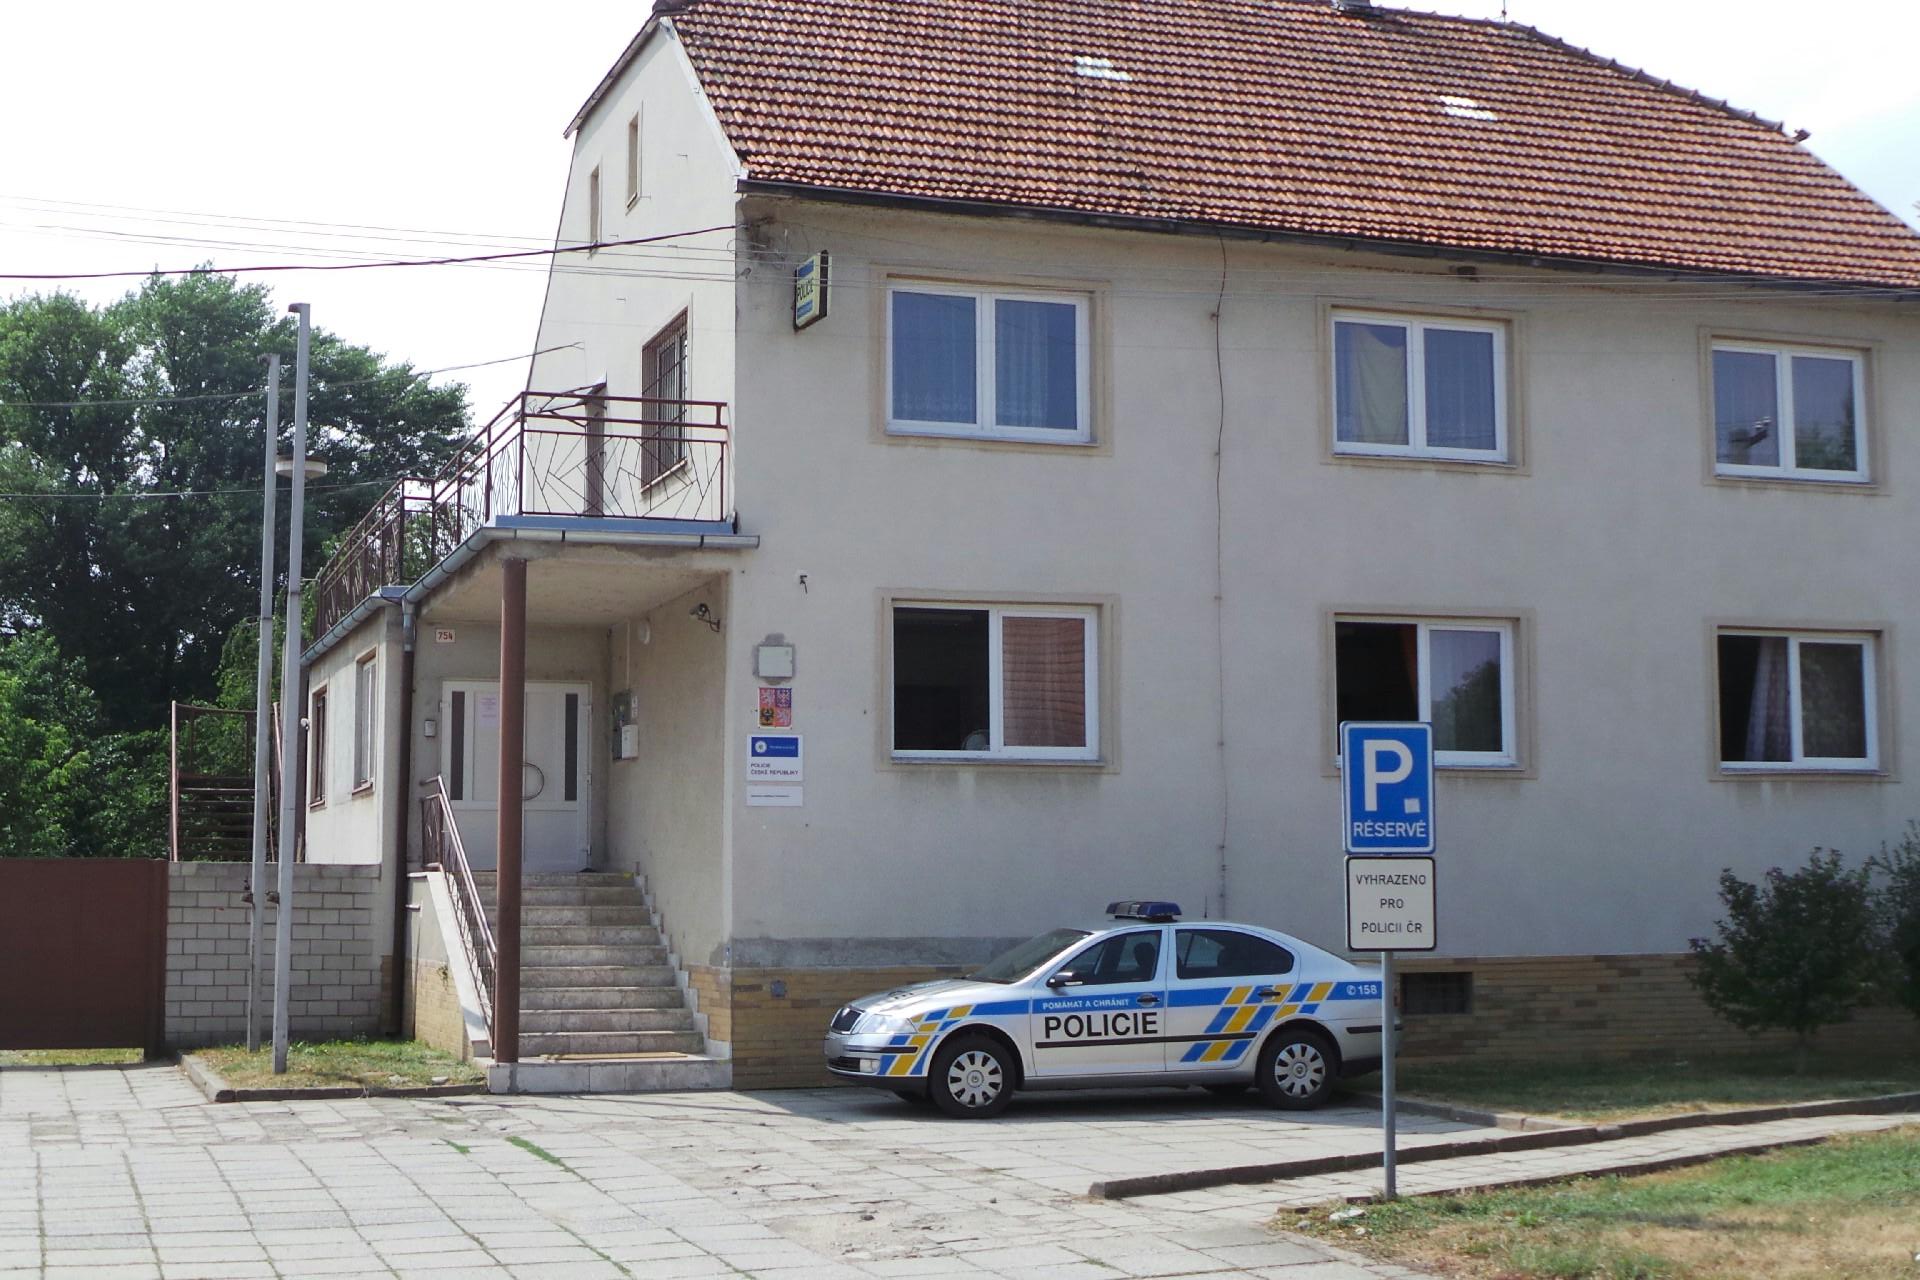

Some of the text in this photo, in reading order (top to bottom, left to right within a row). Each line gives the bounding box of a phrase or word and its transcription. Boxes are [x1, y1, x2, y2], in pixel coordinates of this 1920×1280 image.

[438, 631, 453, 640] 754
[1363, 739, 1413, 812] P
[1356, 874, 1426, 885] VYHRAZENO
[1380, 898, 1404, 909] PRO
[1361, 920, 1423, 933] POLICII ČR
[1358, 984, 1377, 995] 158
[1093, 997, 1129, 1007] CHRÁNIT
[1044, 1012, 1158, 1039] POLICIE
